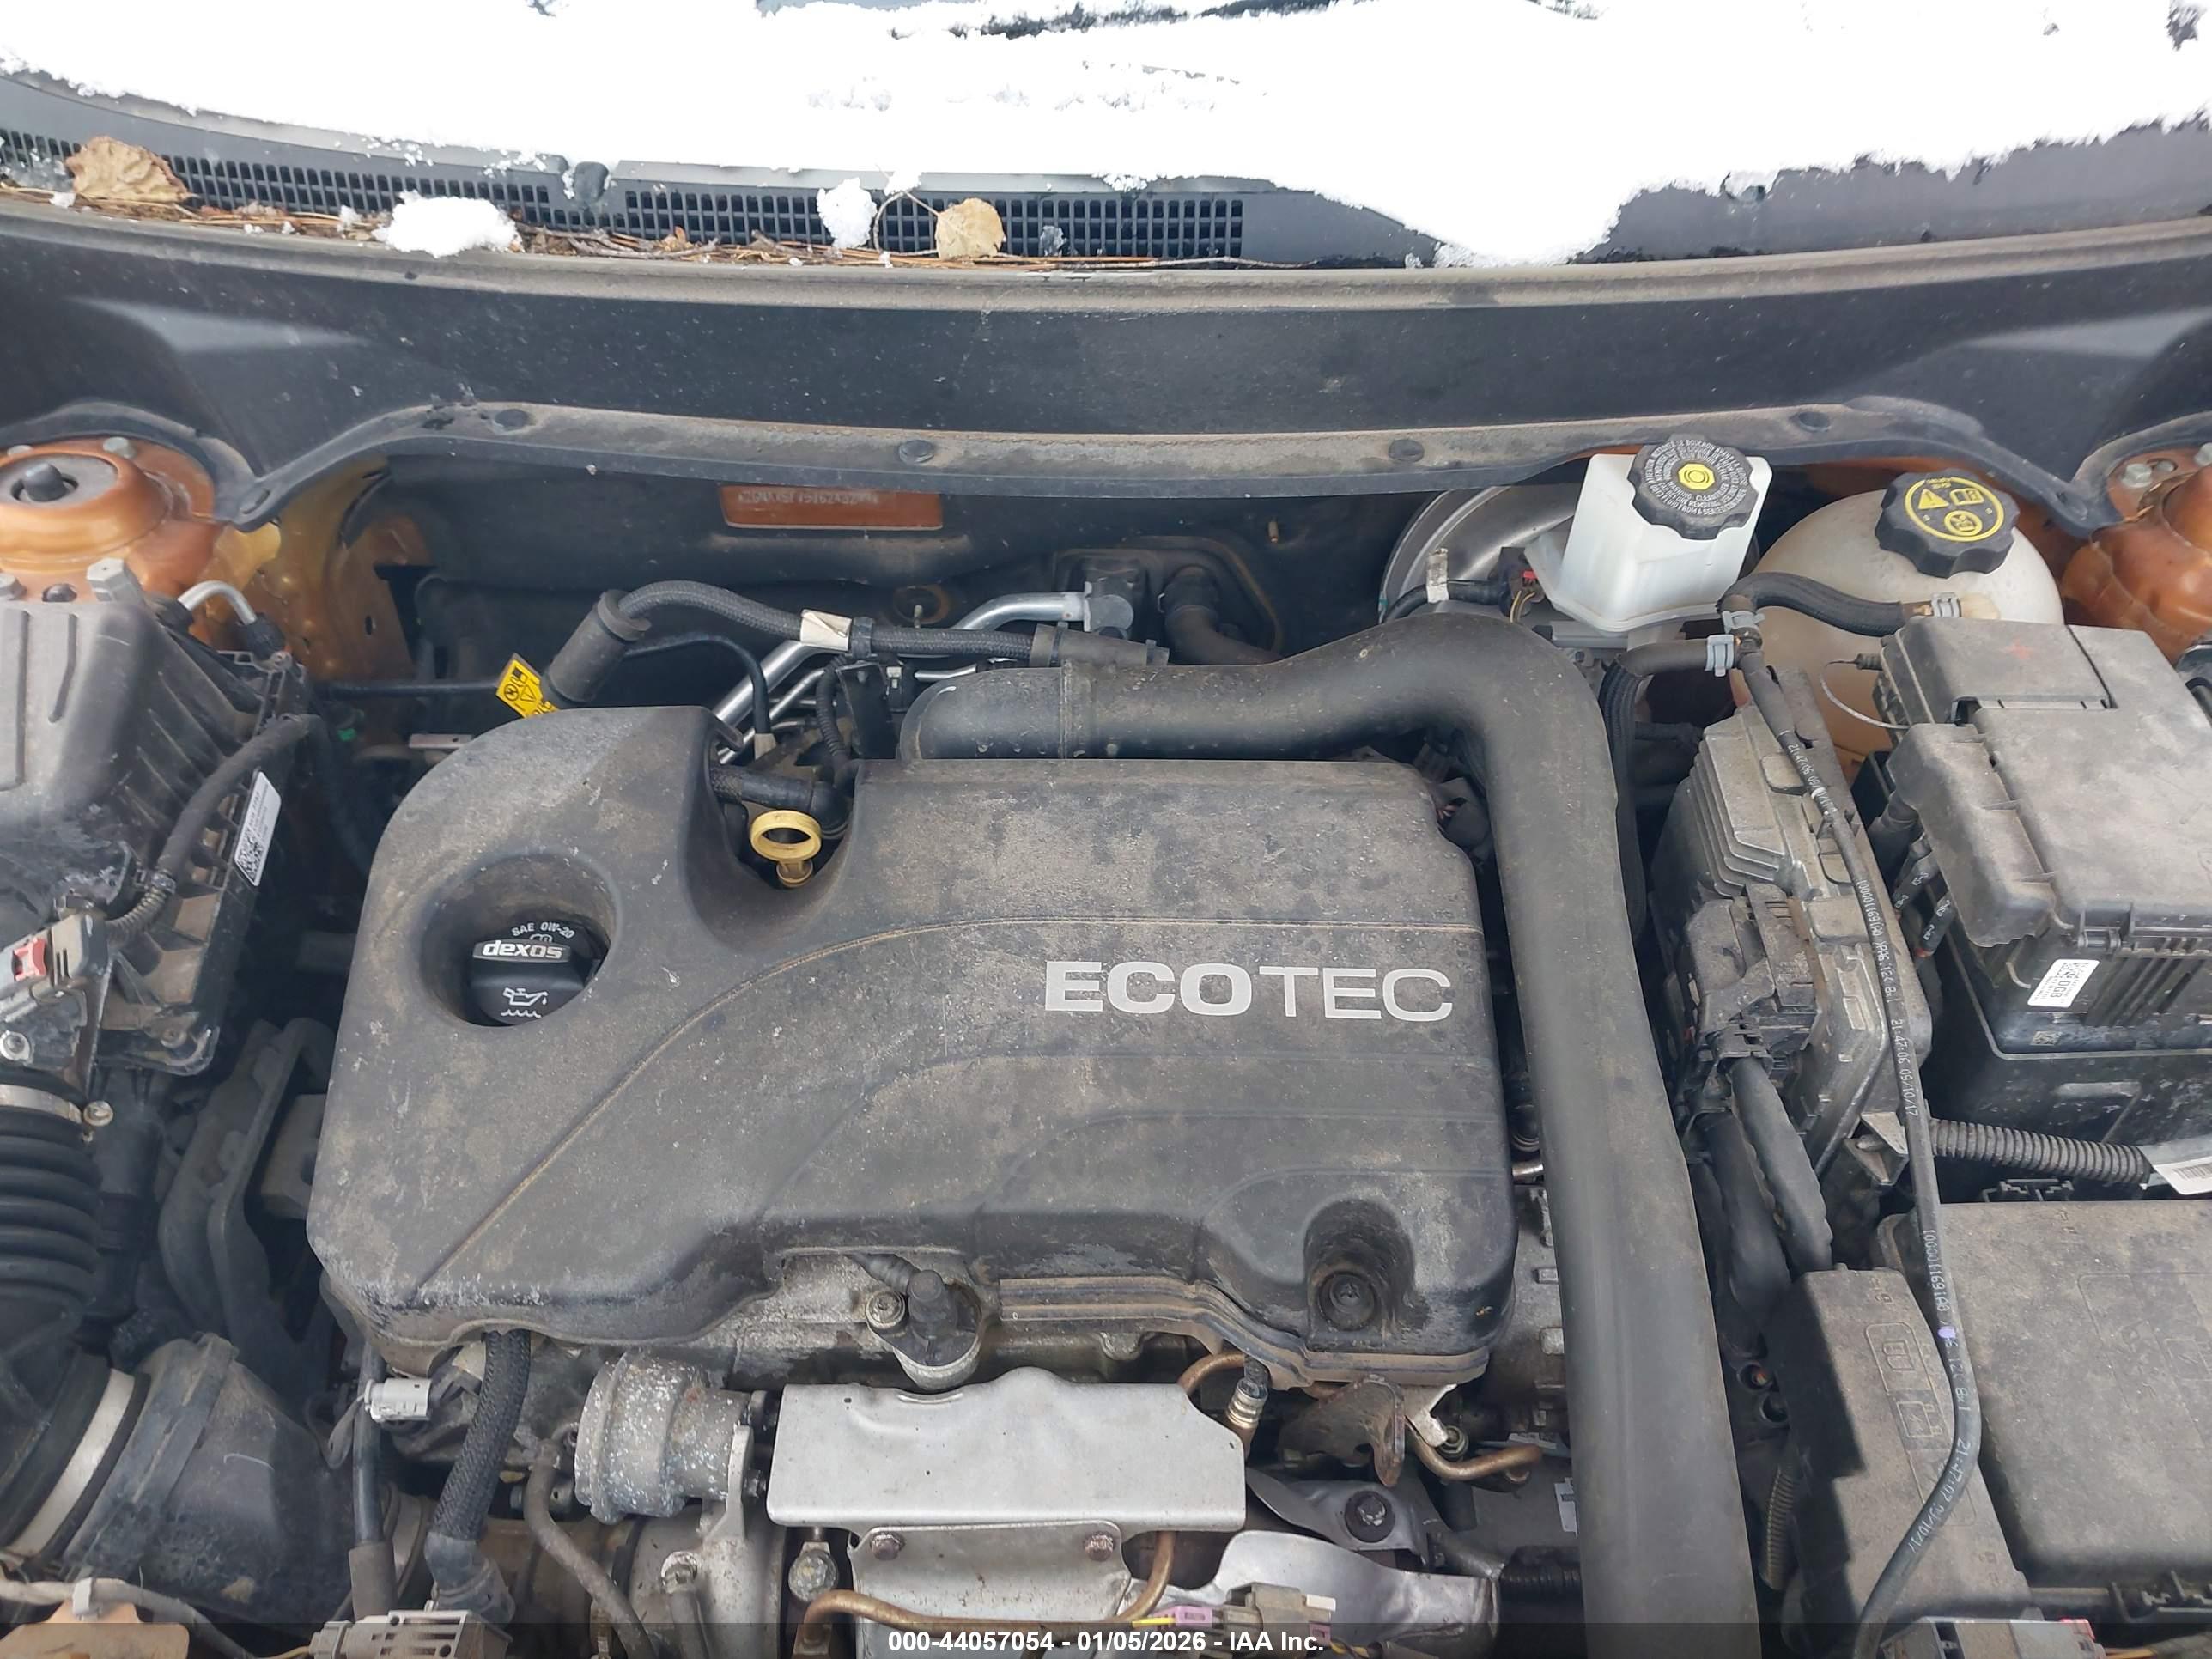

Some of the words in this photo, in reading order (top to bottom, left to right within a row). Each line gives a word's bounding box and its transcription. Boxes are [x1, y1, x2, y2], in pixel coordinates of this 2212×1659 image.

[483, 939, 565, 959] dexos
[511, 922, 535, 937] SAE
[540, 921, 575, 939] 0W-20
[1044, 960, 1453, 1022] ECOTEC
[1891, 1018, 1911, 1065] 21:47:06
[1899, 1068, 1918, 1116] 09/10/17
